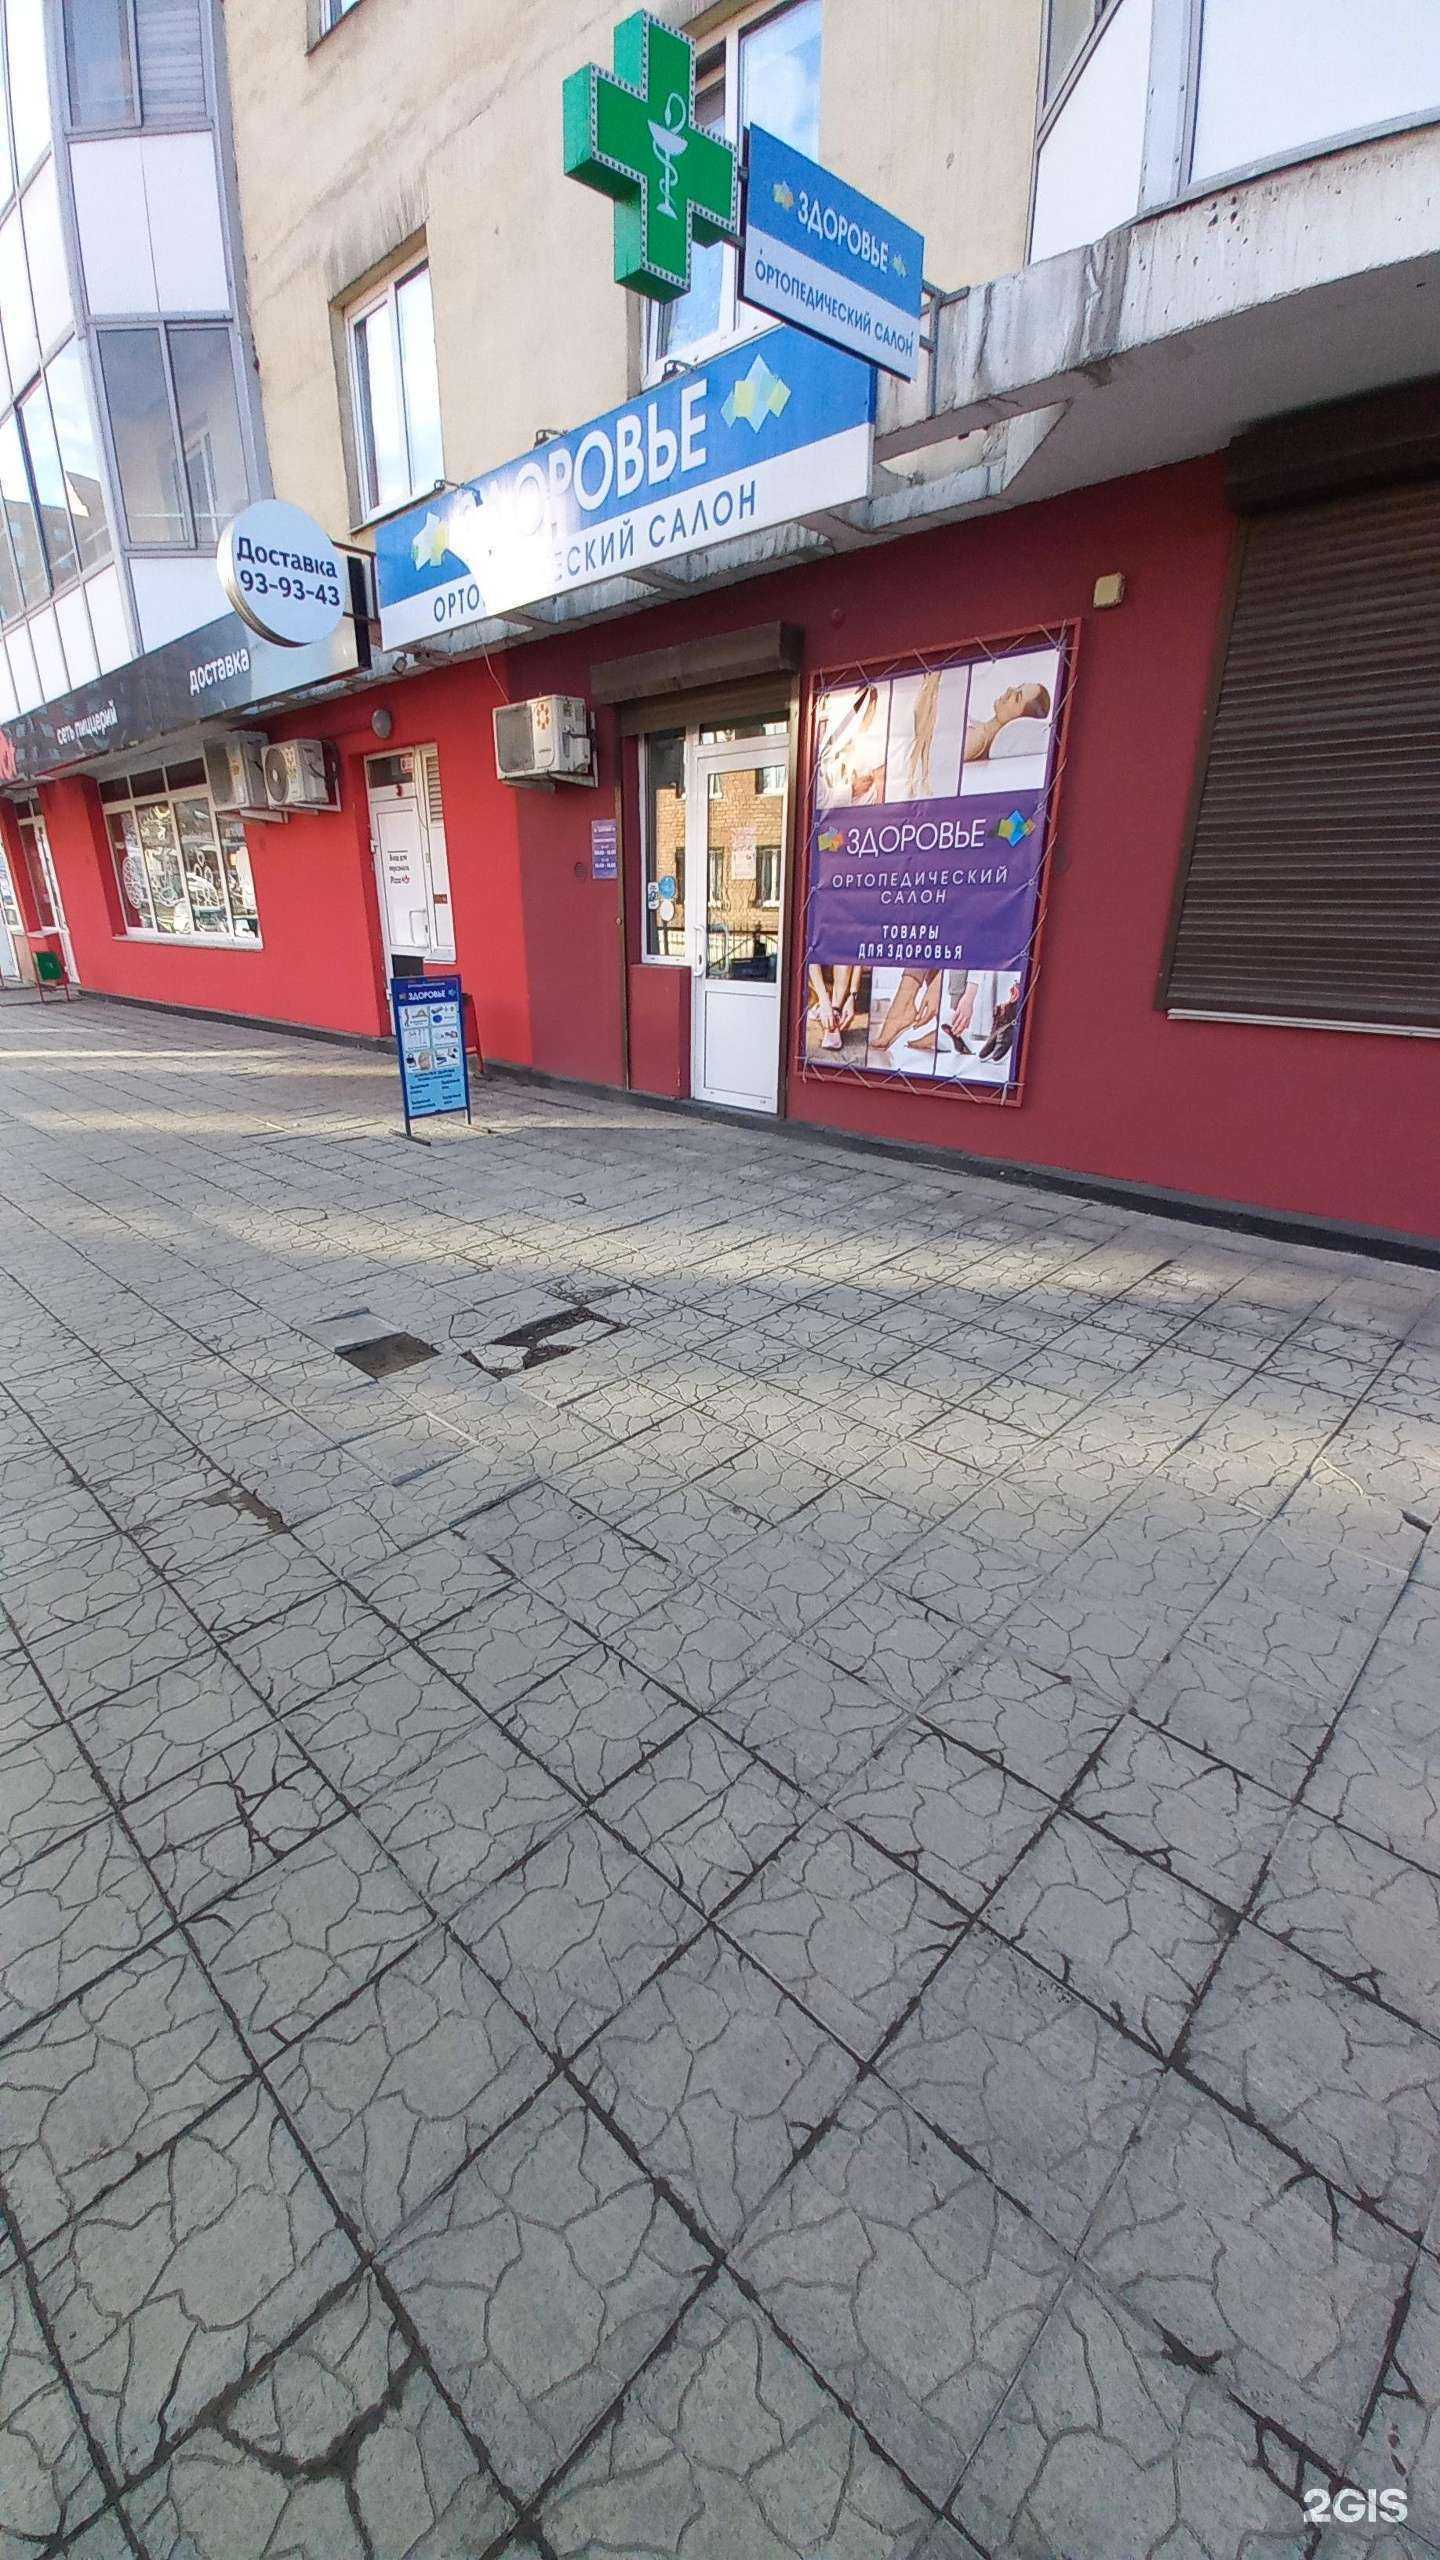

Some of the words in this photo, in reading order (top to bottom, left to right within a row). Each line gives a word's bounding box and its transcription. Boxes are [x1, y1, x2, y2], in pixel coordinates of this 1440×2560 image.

[797, 190, 889, 274] ЗДОРОВЬЕ
[755, 259, 871, 335] ОРТОПЕДИЧЕСКИЙ
[874, 321, 913, 357] САЛОН
[649, 480, 756, 548] САЛОН
[237, 536, 338, 579] Доставка
[240, 570, 340, 606] 93-93-43
[188, 648, 250, 697] доставка
[56, 723, 75, 745] сеть
[75, 699, 119, 738] пиццерий
[846, 818, 987, 858] ЗДОРОВЬЕ
[832, 865, 1008, 888] ОРТОПЕДИЧЕСКИЙ
[881, 890, 947, 904] САЛОН
[858, 943, 883, 959] ДЛЯ
[887, 943, 963, 960] ЗДОРОВЬЯ
[882, 925, 939, 940] ТОВАРЫ
[408, 989, 446, 1001] ЗДОРОВЬЕ
